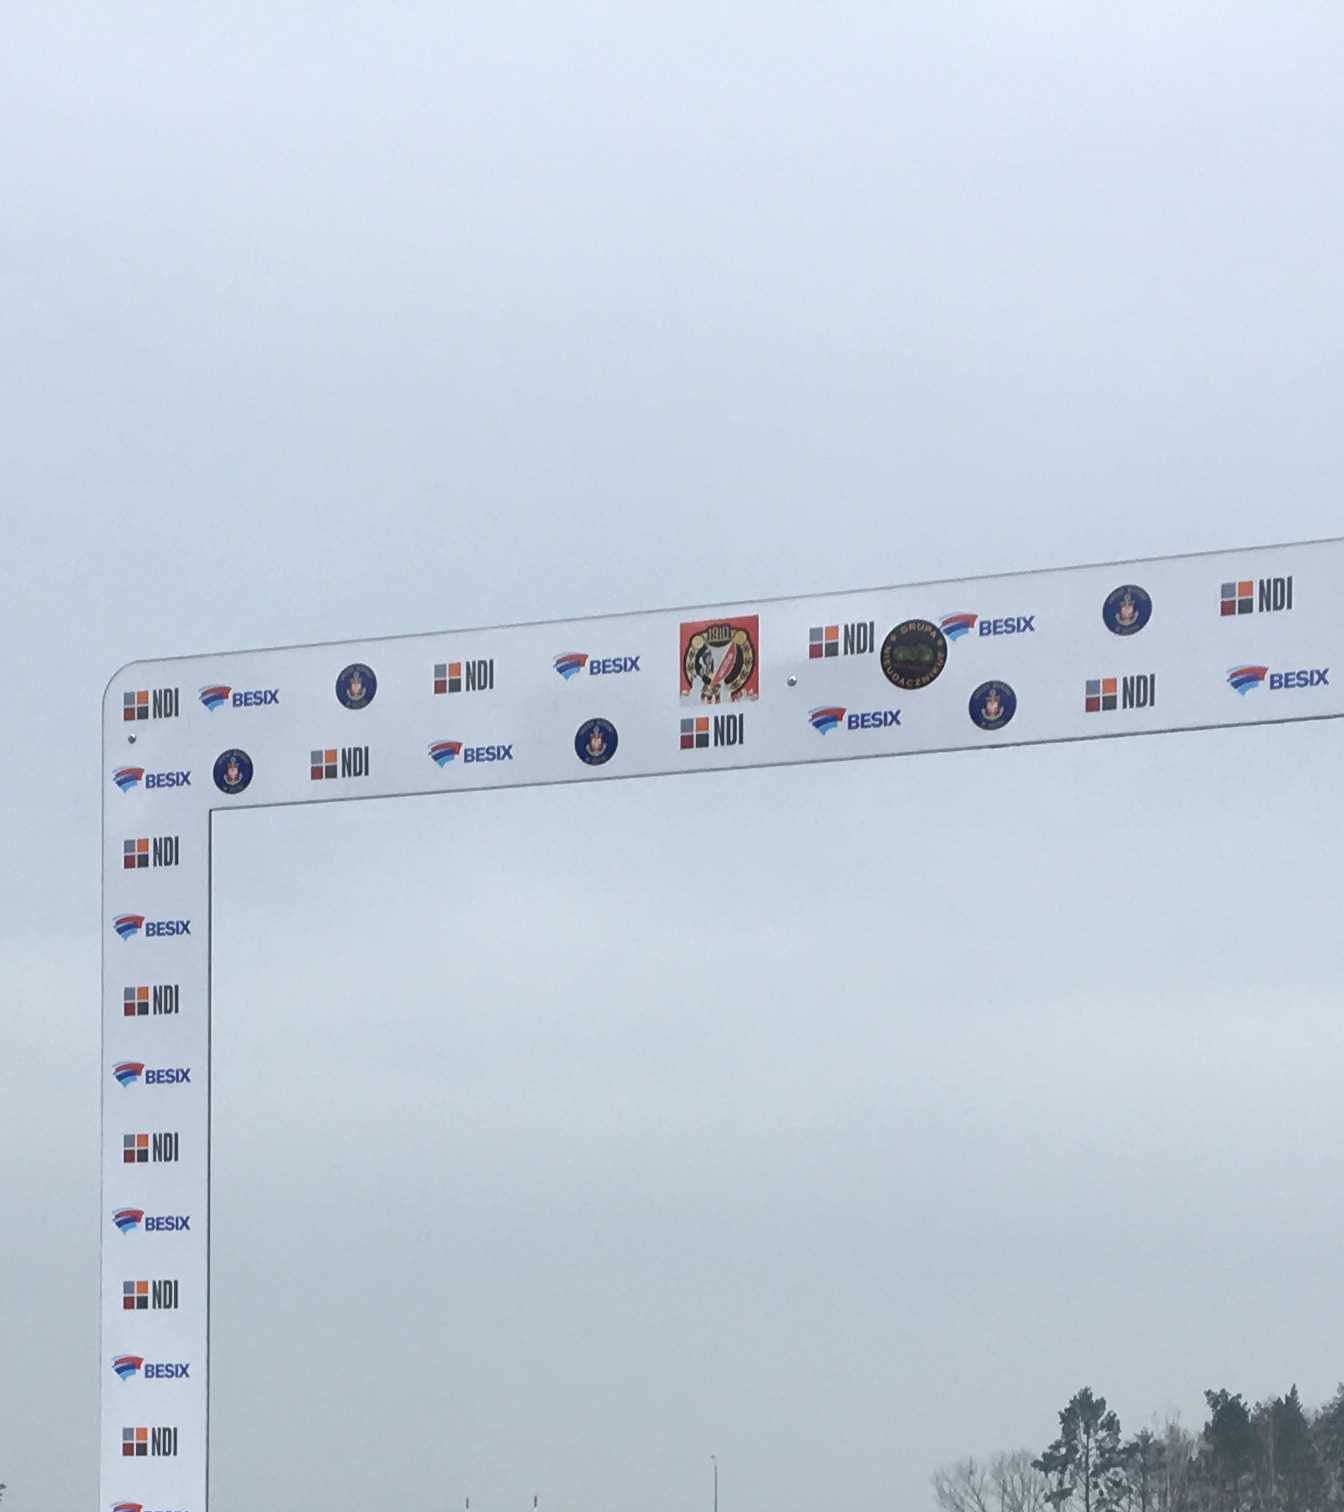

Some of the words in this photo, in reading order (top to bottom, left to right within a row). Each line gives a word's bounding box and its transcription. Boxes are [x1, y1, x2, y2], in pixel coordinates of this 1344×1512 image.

[1258, 575, 1293, 613] NDI
[843, 620, 875, 657] NDI
[978, 615, 1035, 637] BESIX
[465, 658, 494, 692] NDI
[589, 655, 641, 676] BESIX
[1269, 667, 1330, 691] BESIX
[152, 687, 180, 720] NDI
[232, 689, 280, 708] BESIX
[1122, 673, 1156, 710] NDI
[713, 712, 744, 748] NDI
[847, 709, 902, 731] BESIX
[341, 745, 370, 779] NDI
[463, 744, 514, 764] BESIX
[145, 770, 192, 790] BESIX
[152, 835, 180, 868] NDI
[145, 919, 192, 938] BESIX
[152, 984, 180, 1016] NDI
[145, 1067, 191, 1085] BESIX
[152, 1131, 179, 1163] NDI
[144, 1215, 191, 1232] BESIX
[152, 1279, 179, 1310] NDI
[144, 1363, 190, 1379] BESIX
[151, 1426, 178, 1457] NDI
